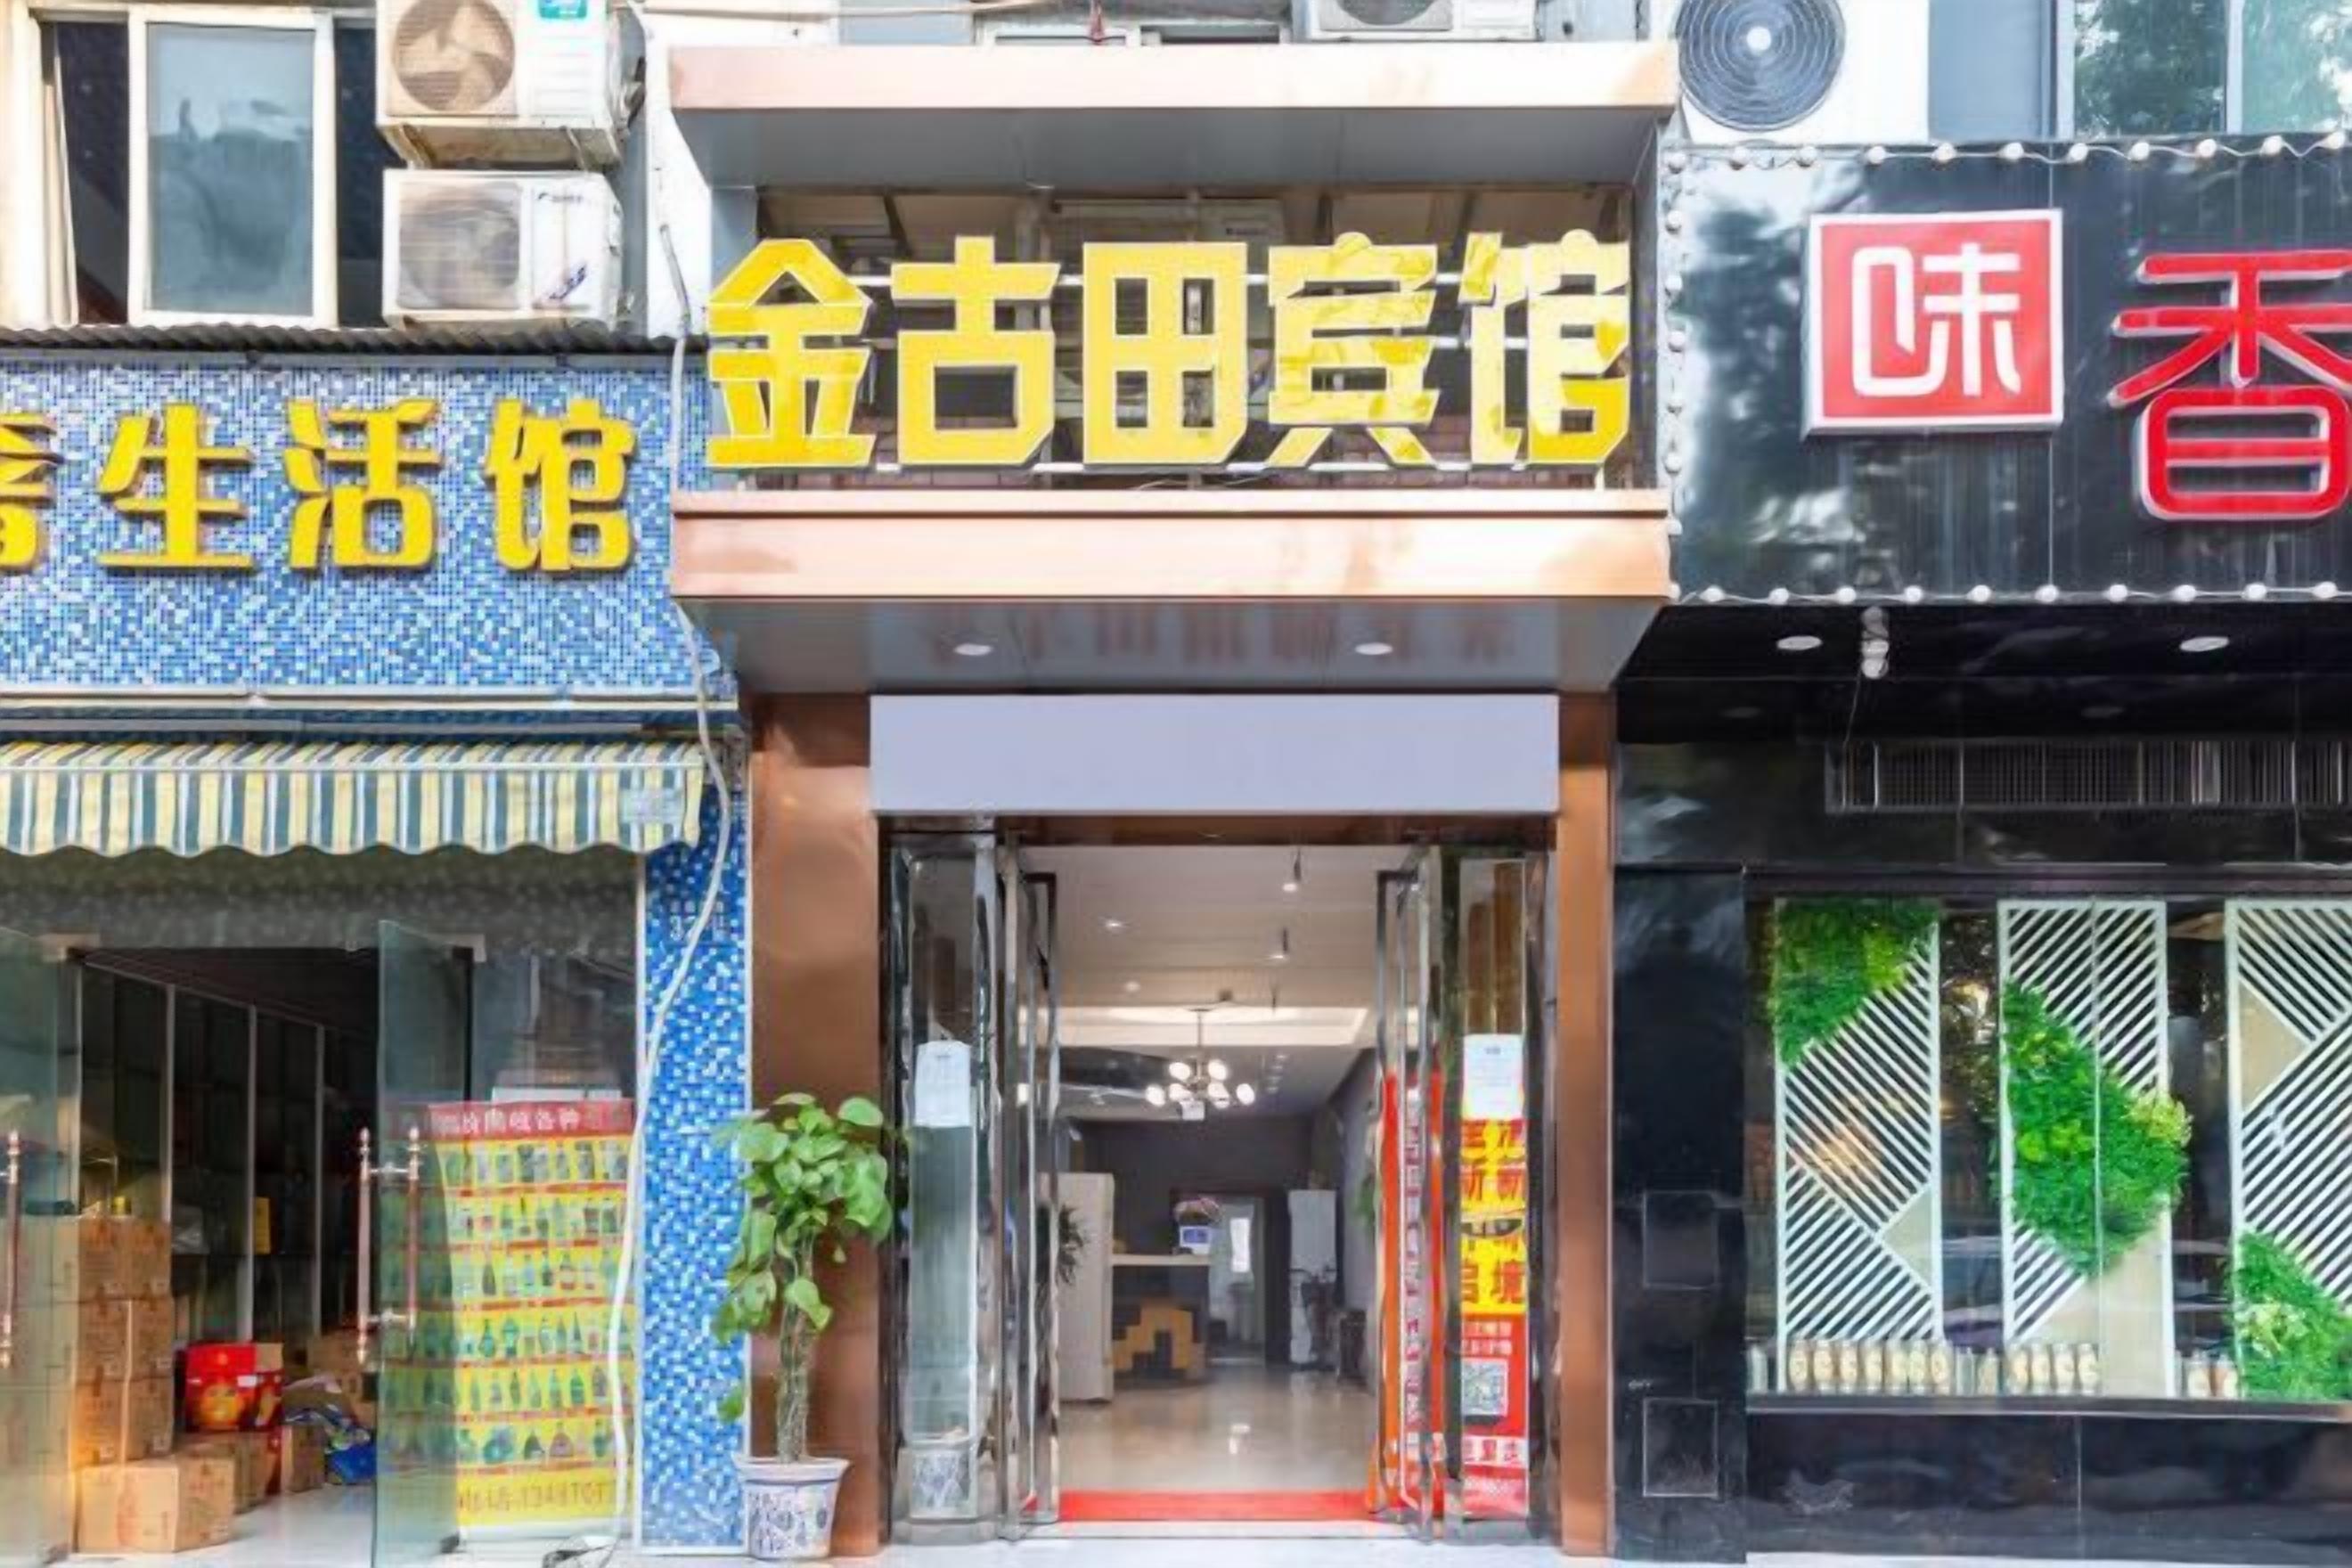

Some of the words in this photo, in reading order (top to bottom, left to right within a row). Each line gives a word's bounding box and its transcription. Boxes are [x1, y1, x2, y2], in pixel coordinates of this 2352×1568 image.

[706, 231, 1630, 468] 金古田宾馆
[2109, 249, 2352, 520] 香
